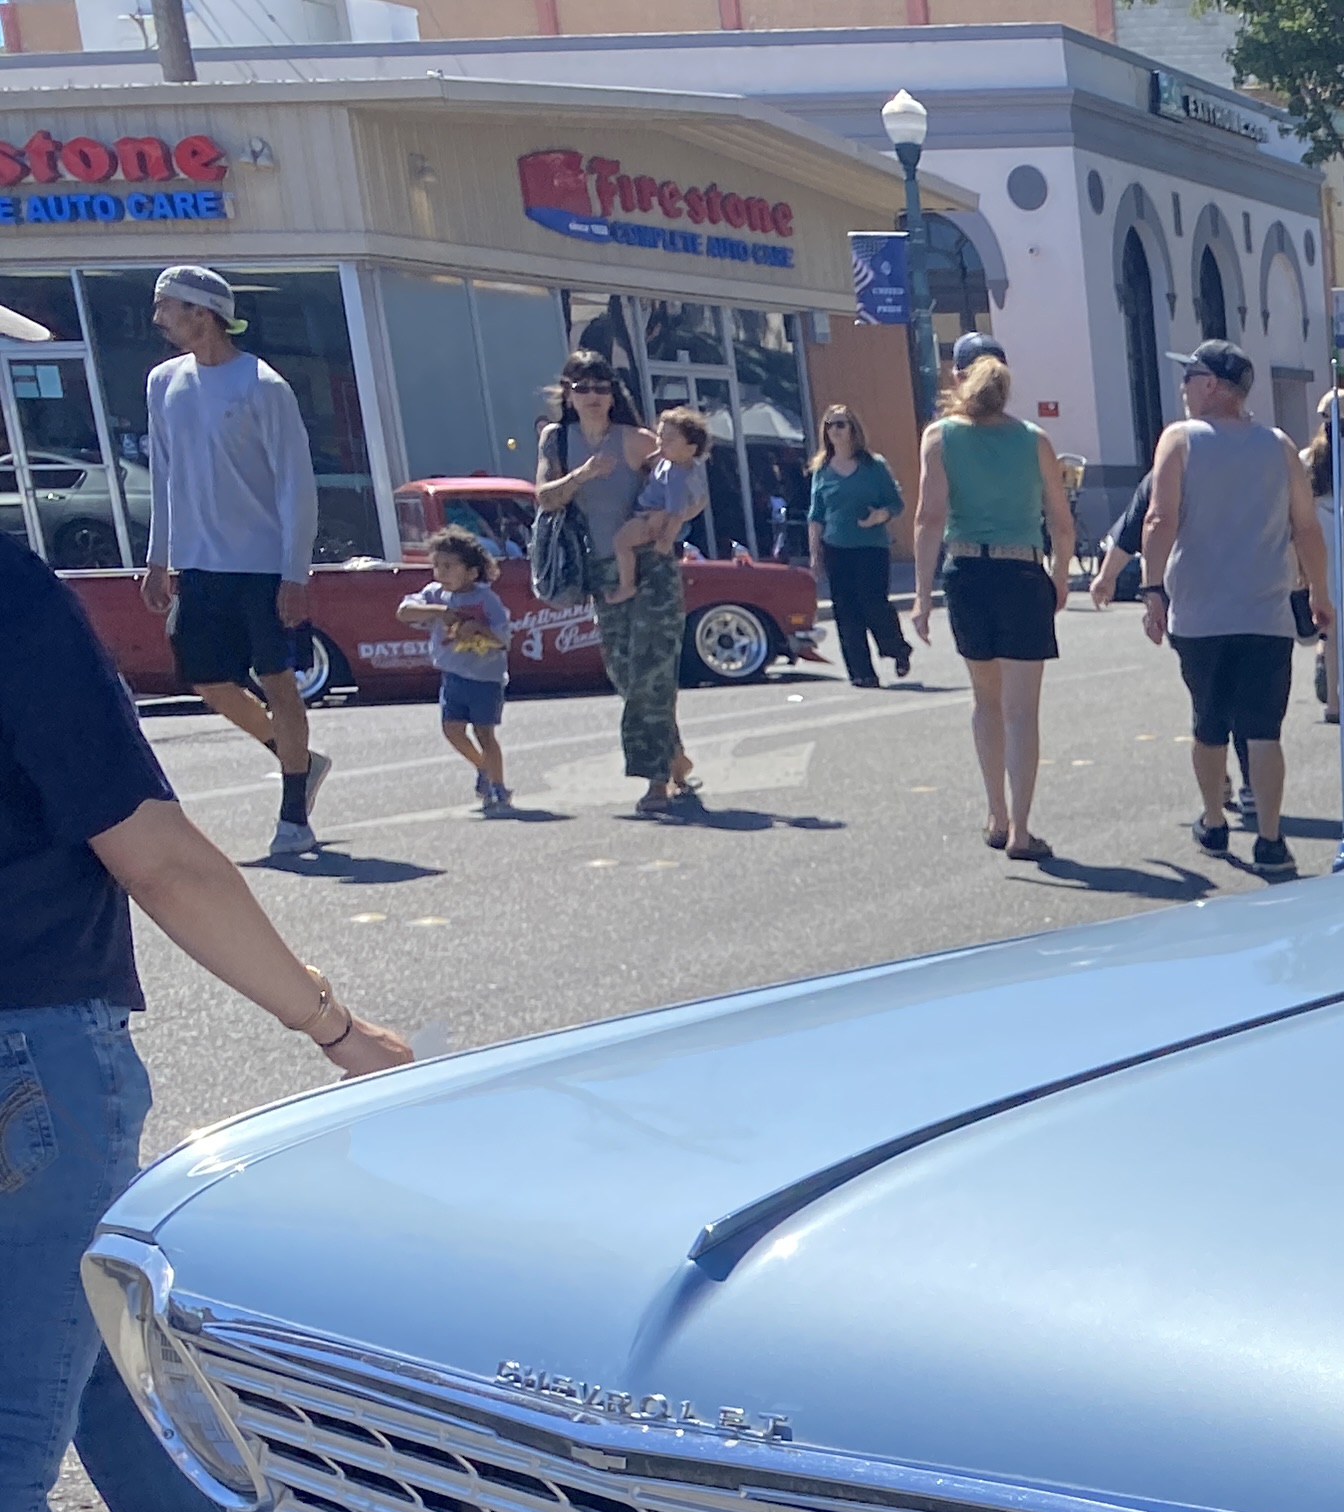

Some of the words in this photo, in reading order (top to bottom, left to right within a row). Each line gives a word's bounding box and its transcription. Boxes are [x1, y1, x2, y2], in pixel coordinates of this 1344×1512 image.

[26, 193, 124, 223] AUTO
[127, 190, 228, 220] CARE
[586, 155, 794, 238] Firestone
[609, 221, 703, 255] COMPLETE
[706, 235, 750, 262] AUTO
[357, 640, 435, 659] DATSU
[496, 1360, 793, 1442] CHEVROLET
